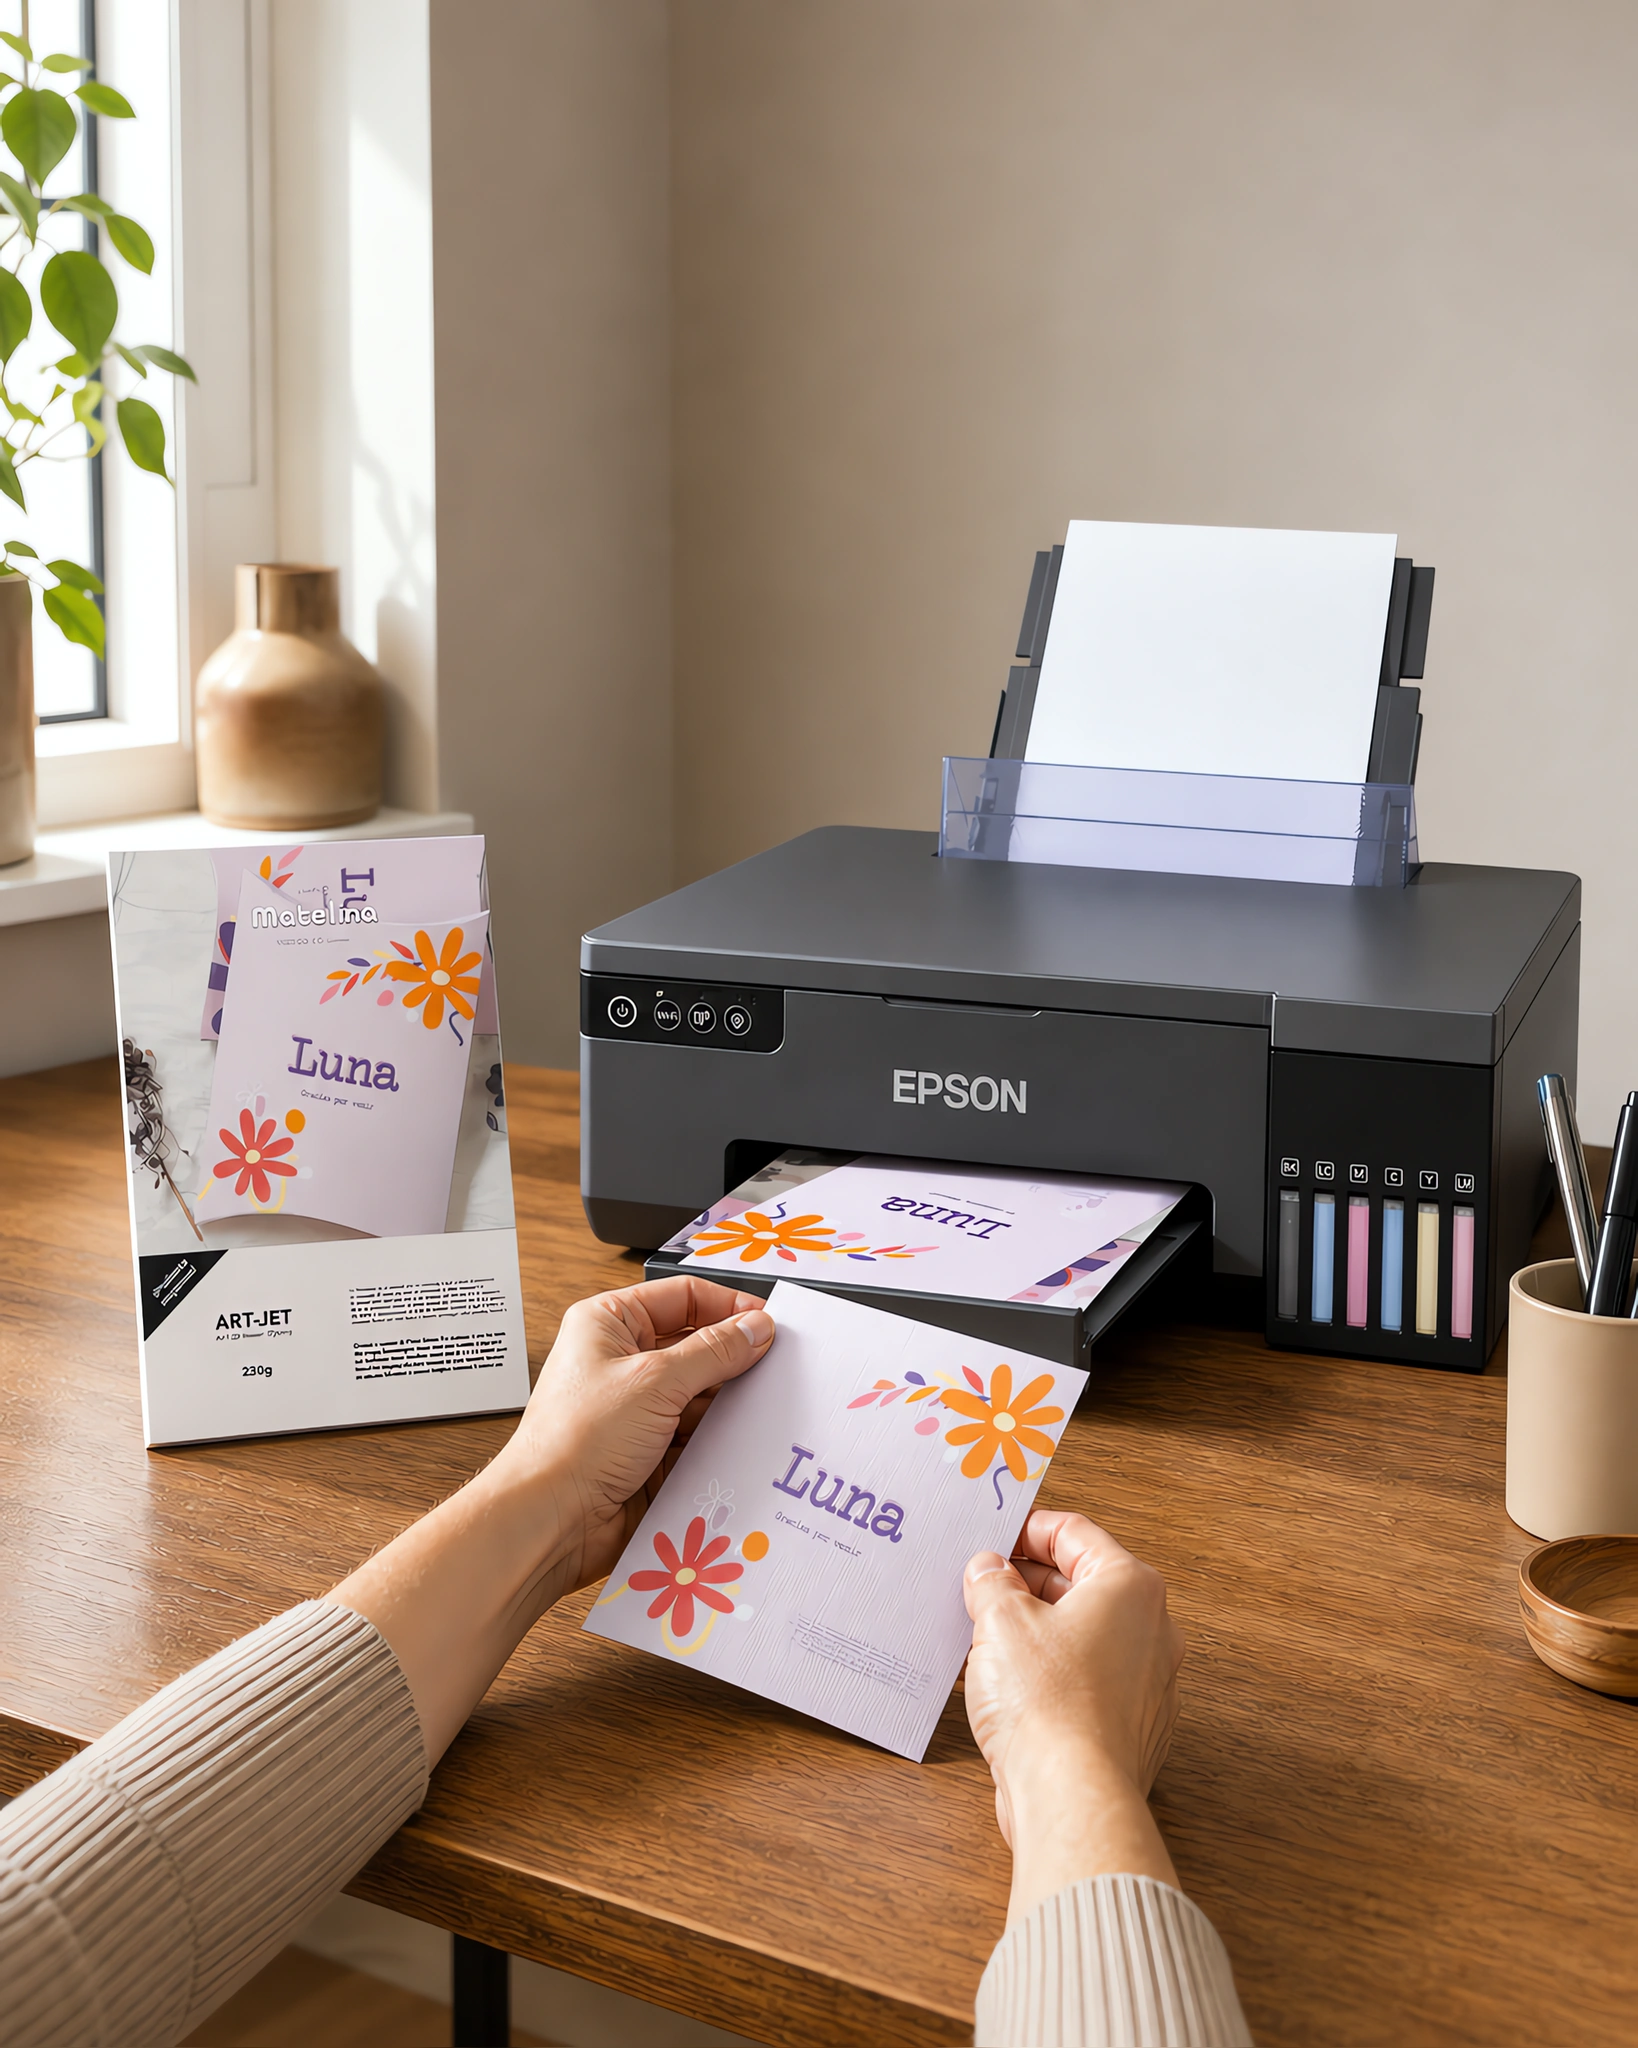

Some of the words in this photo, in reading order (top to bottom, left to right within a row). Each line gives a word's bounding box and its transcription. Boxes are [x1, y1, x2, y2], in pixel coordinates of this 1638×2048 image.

[251, 900, 380, 930] Matelina
[286, 1033, 400, 1093] Luna
[892, 1068, 1028, 1114] EPSON
[1318, 1165, 1332, 1176] LC
[1389, 1172, 1399, 1182] C
[1424, 1175, 1434, 1186] Y
[881, 1194, 1013, 1241] Luna
[215, 1307, 293, 1332] ART-JET
[241, 1364, 274, 1379] 230g
[771, 1443, 907, 1544] Luna
